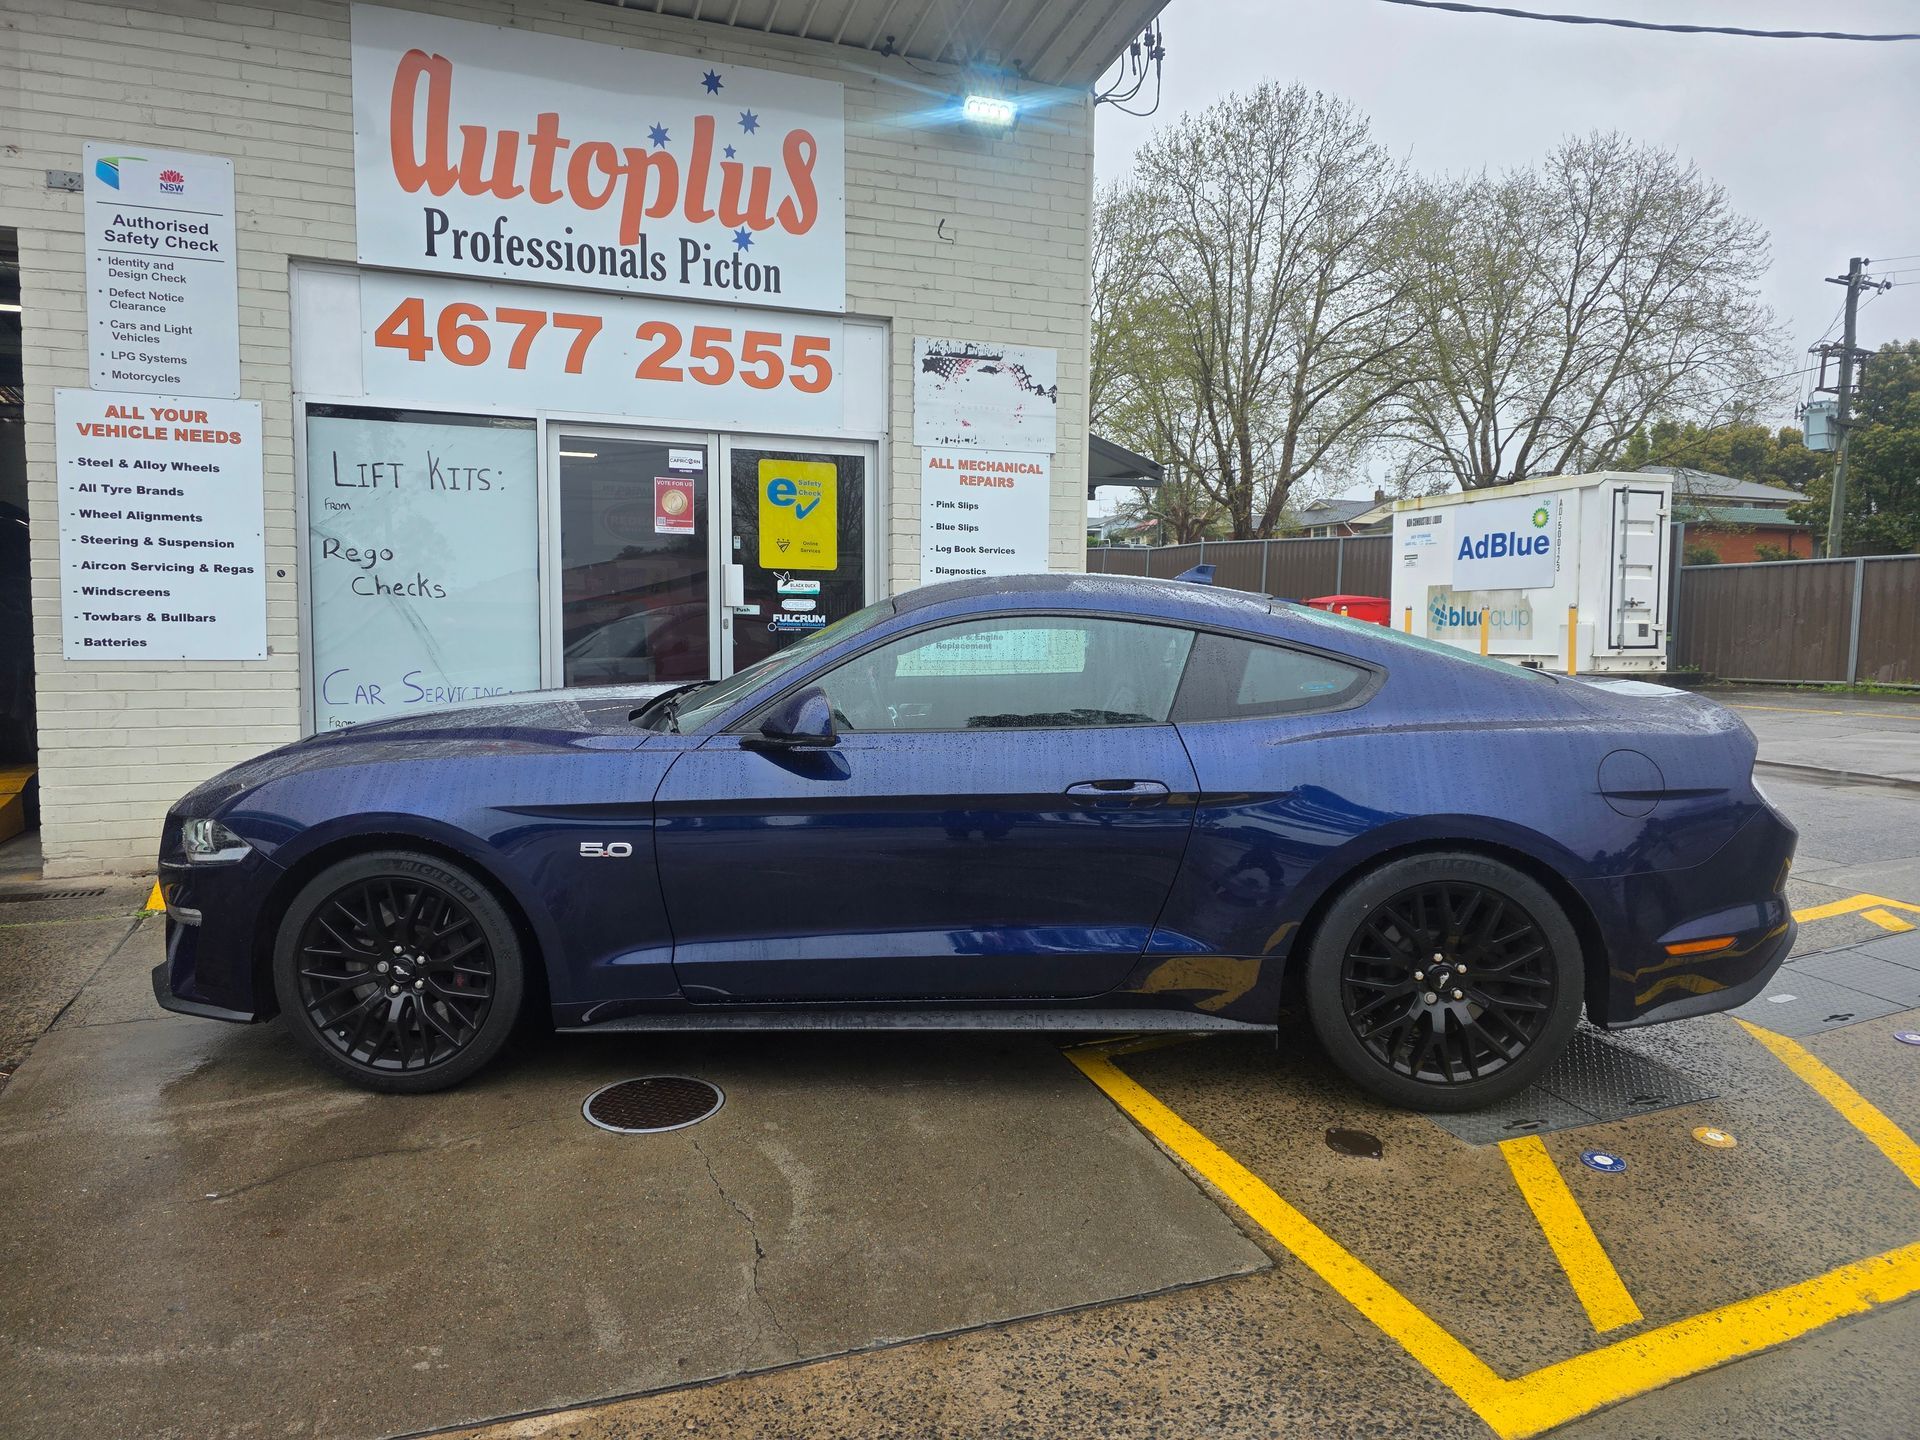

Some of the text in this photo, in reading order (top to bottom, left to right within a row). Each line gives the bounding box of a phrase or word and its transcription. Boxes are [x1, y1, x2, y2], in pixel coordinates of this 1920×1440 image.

[160, 182, 184, 192] NSW
[112, 213, 209, 236] Authorised
[104, 229, 219, 253] Safety Check
[423, 206, 782, 294] Professionals Picton
[108, 256, 174, 271] Identity and
[108, 268, 187, 284] Design Check
[109, 287, 185, 303] Defect Notice
[109, 300, 166, 314] Clearance
[110, 319, 193, 335] Cars and Light
[112, 331, 160, 344] Vehicles
[374, 297, 833, 394] 4677 2555
[111, 351, 187, 365] LPG Systems
[112, 370, 181, 384] Motorcycles
[105, 405, 208, 424] ALL YOUR
[76, 423, 242, 445] VEHICLE NEEDS
[77, 457, 220, 473] Steel & Alloy Wheels
[332, 450, 404, 489] LIFT
[929, 457, 1043, 475] ALL MECHANICAL
[798, 480, 822, 488] Safety
[959, 474, 1015, 488] REPAIRS
[78, 483, 184, 496] All Tyre Brands
[768, 479, 797, 507] e
[936, 500, 979, 511] Pink Slips
[1543, 499, 1552, 507] bp
[79, 509, 203, 523] Wheel Alignments
[936, 523, 979, 533] Blue Slips
[80, 535, 235, 549] Steering & Suspension
[1457, 531, 1550, 561] AdBlue
[322, 537, 394, 570] Rego
[935, 545, 1016, 555] Log Book Services
[81, 561, 254, 575] Aircon Servicing & Regas
[935, 567, 987, 577] Diagnostics
[81, 586, 171, 597] Windscreens
[352, 572, 447, 599] Checks
[82, 612, 216, 623] Towbars & Bullbars
[773, 613, 826, 624] FULCRUM
[83, 637, 147, 648] Batteries
[975, 634, 1004, 642] Engine
[936, 642, 992, 651] Replacement
[322, 668, 385, 705] CAR
[580, 842, 633, 858] 5.0
[399, 860, 478, 900] MICHELIN
